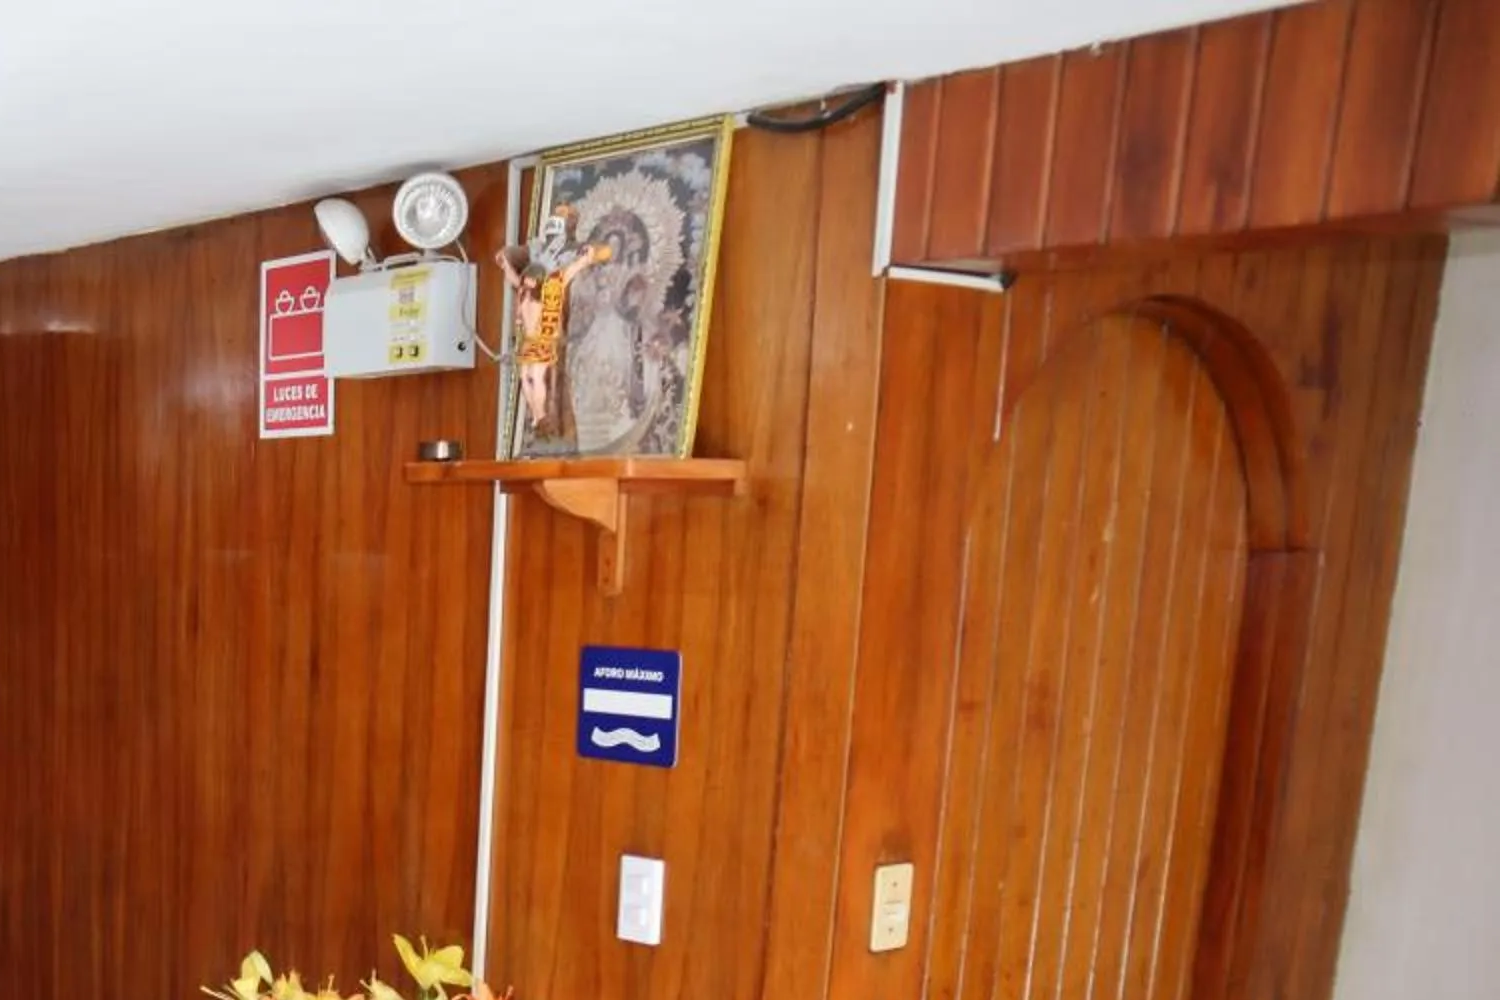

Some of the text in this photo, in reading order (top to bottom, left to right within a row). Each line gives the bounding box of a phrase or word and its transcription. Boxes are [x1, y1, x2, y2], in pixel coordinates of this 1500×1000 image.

[273, 383, 319, 402] LUCES DE
[266, 404, 326, 423] EMERGENCIA
[593, 667, 624, 679] AFORO
